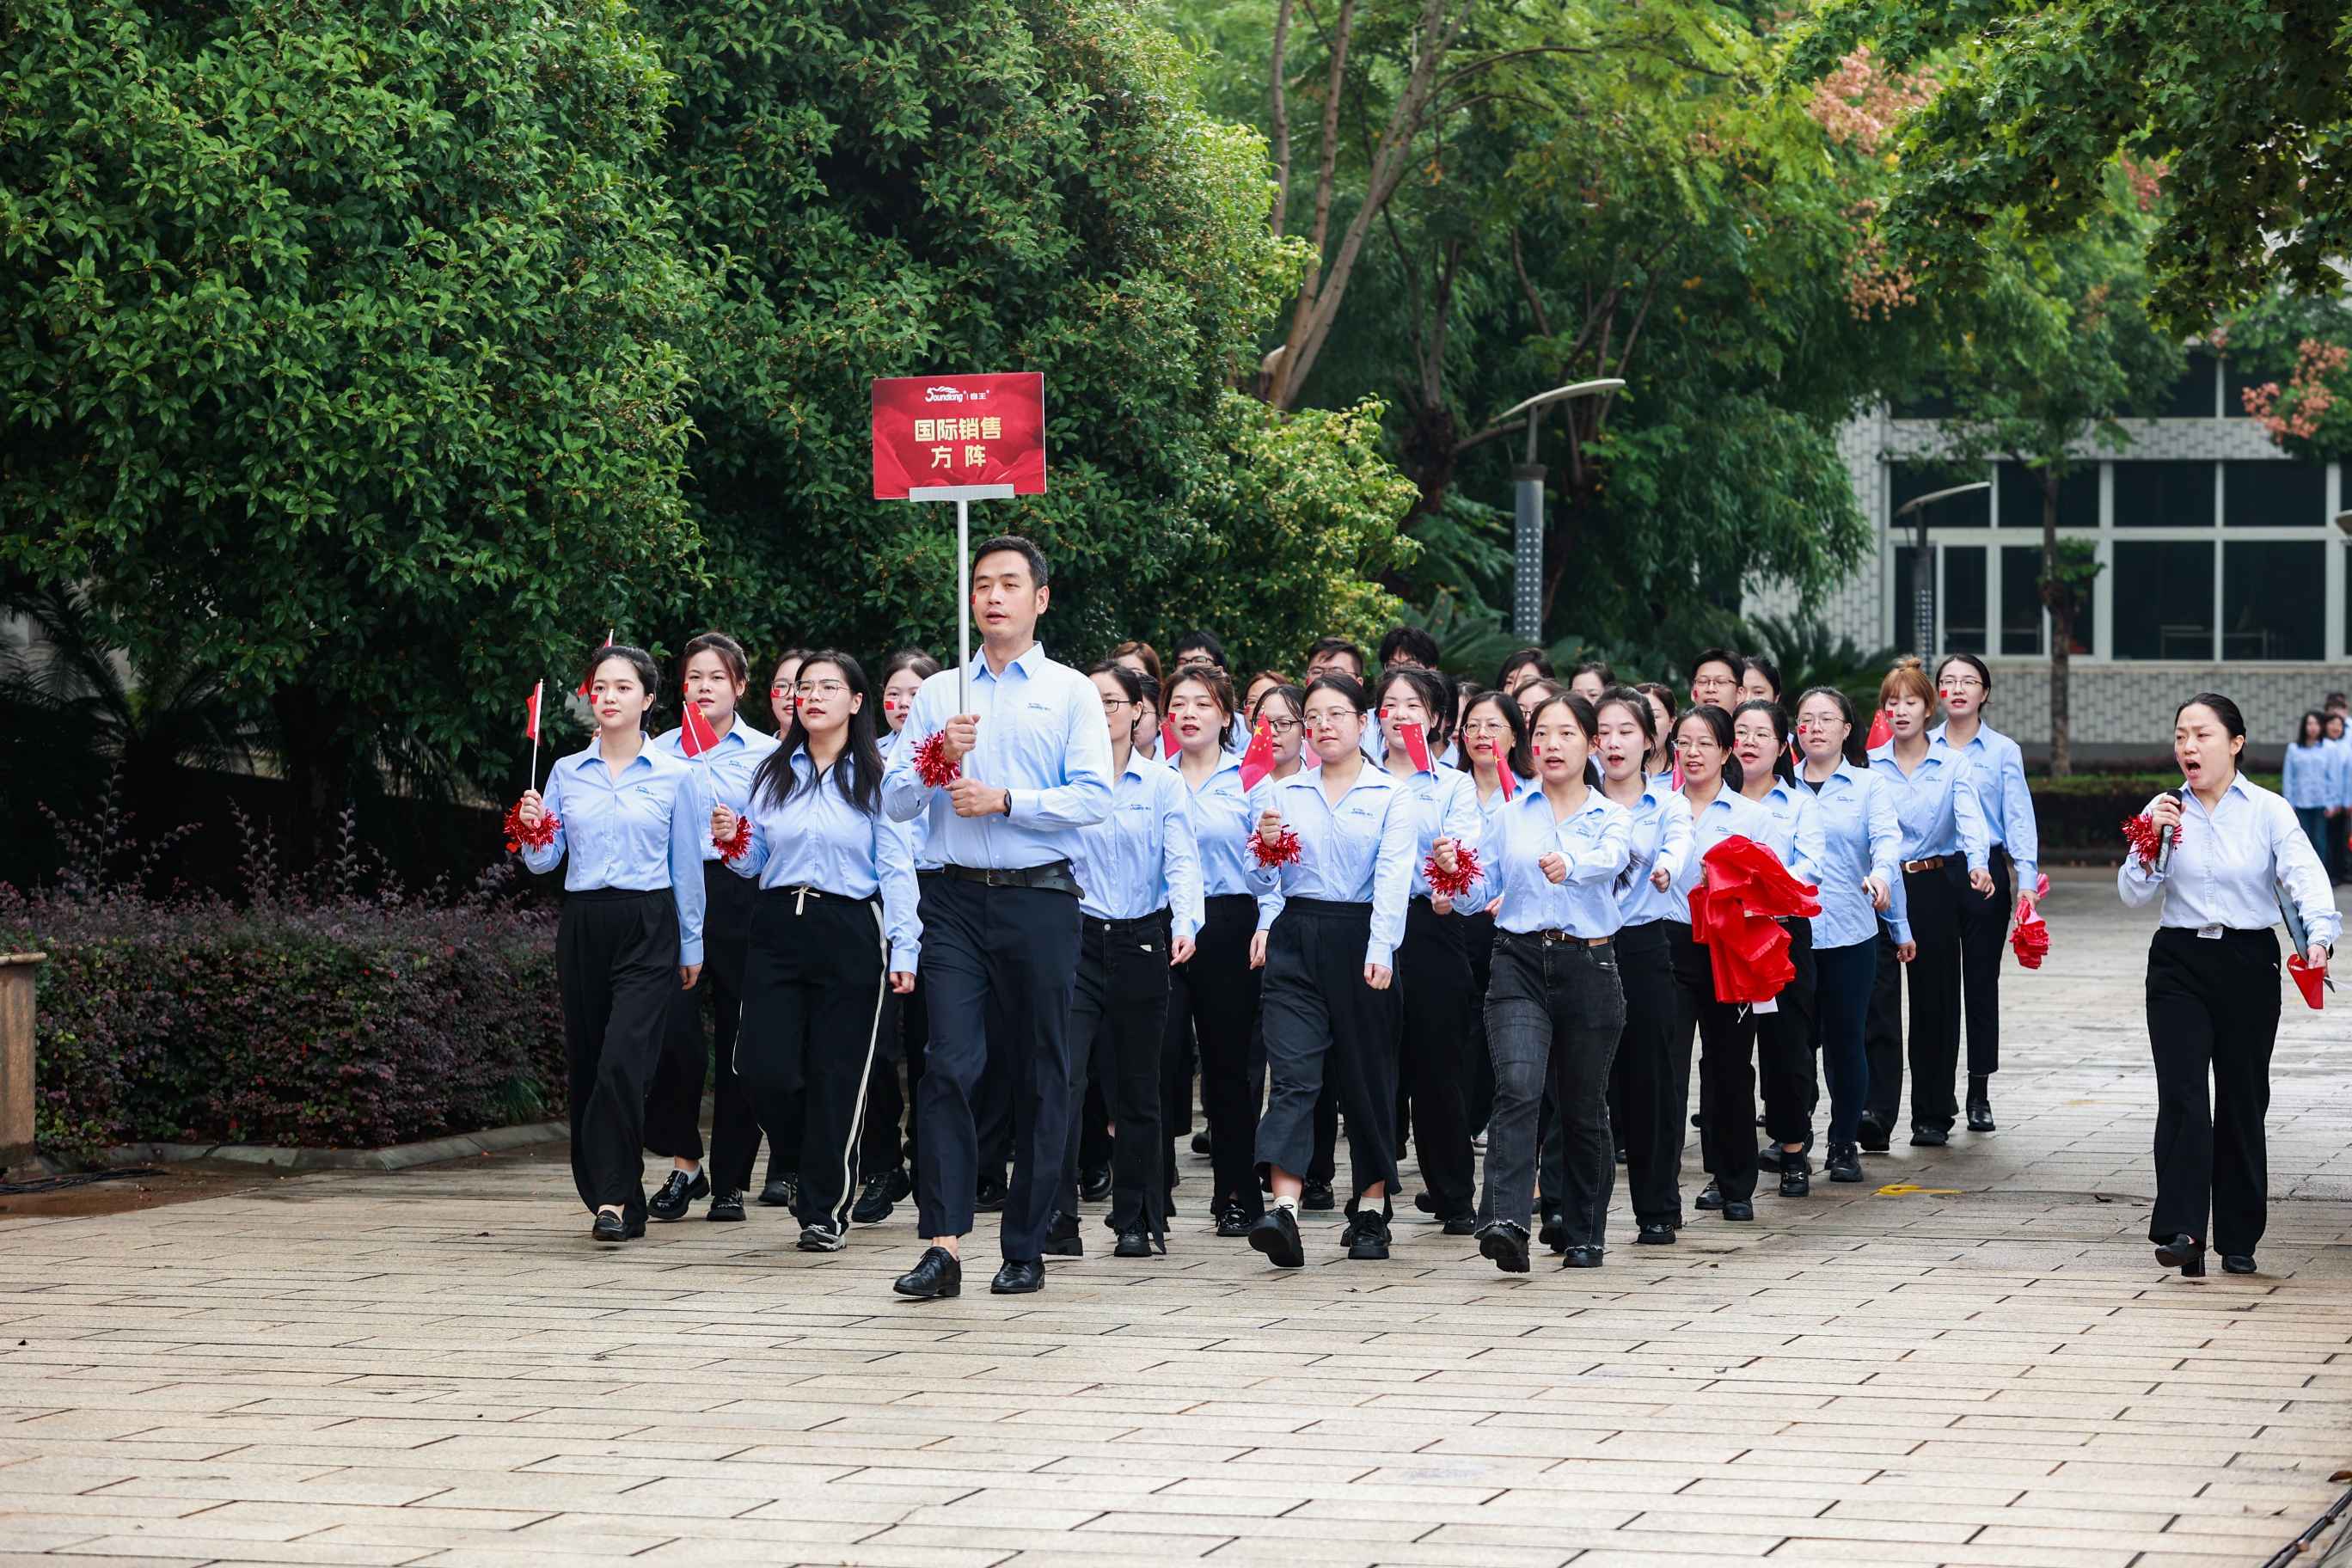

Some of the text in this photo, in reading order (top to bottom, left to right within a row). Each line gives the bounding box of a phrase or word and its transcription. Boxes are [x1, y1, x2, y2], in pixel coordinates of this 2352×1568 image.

[915, 417, 1001, 441] 国际销售
[931, 444, 986, 468] 方阵
